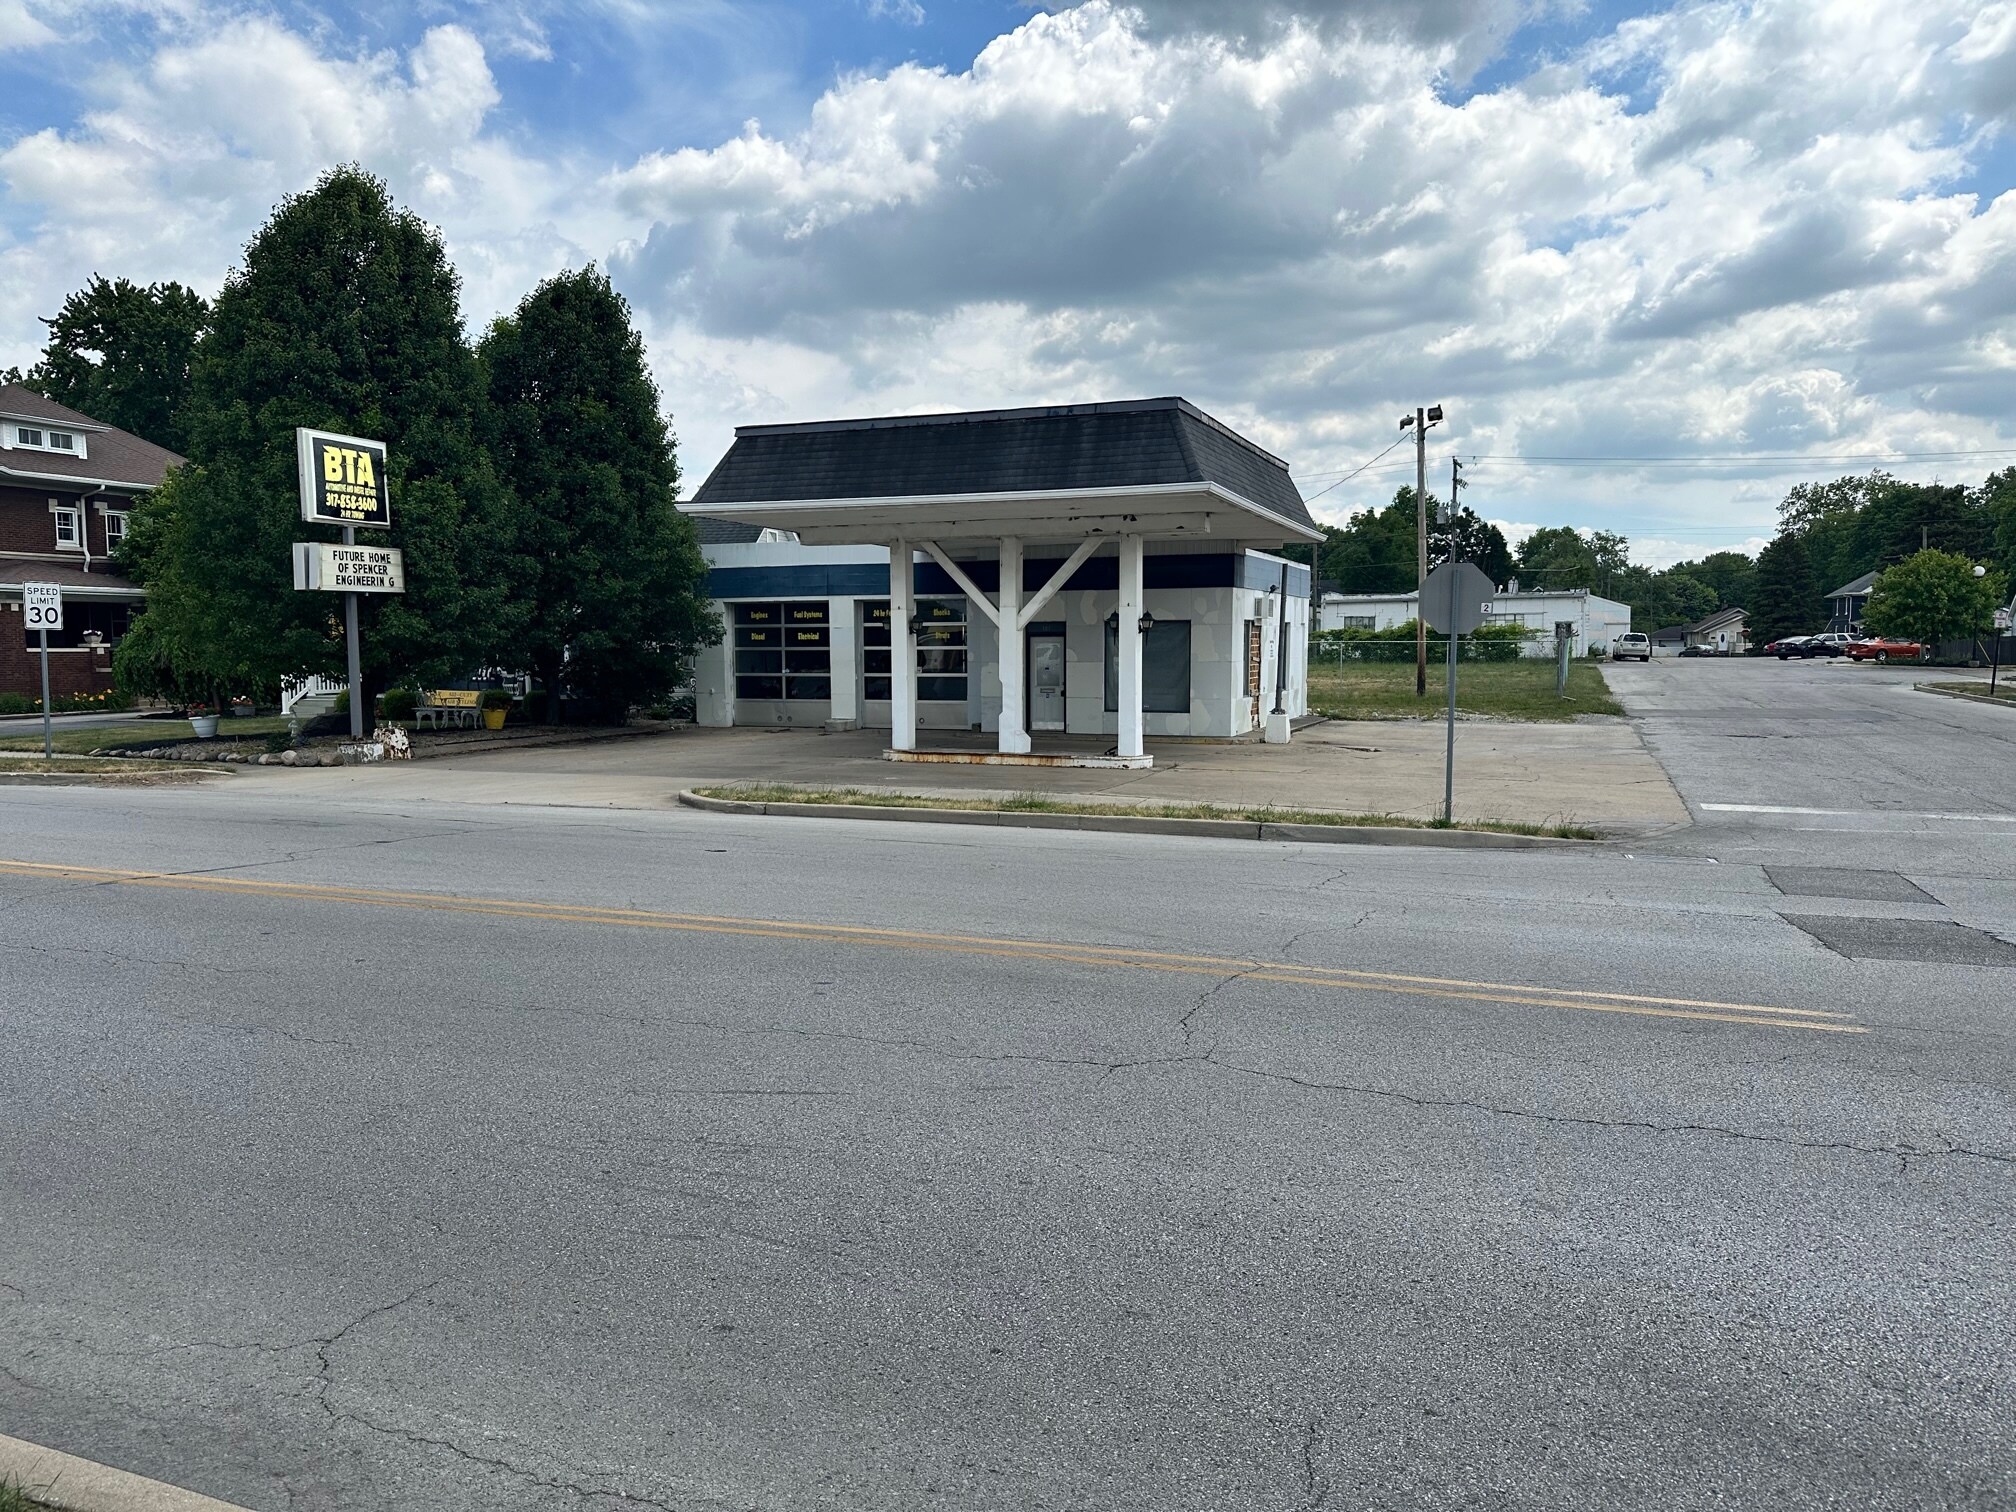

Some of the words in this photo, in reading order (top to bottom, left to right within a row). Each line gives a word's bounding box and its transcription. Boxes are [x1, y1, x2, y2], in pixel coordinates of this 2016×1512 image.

[323, 445, 375, 488] BTA
[325, 492, 377, 512] 317-858-3600
[332, 550, 365, 562] FUTURE
[368, 552, 391, 564] HOME
[338, 562, 349, 573] OF
[352, 563, 388, 575] SPENCER
[335, 574, 385, 587] ENGINEERIN
[388, 576, 395, 587] G
[27, 587, 58, 596] SPEED
[30, 597, 55, 605] LIMIT
[1483, 604, 1489, 612] 2
[29, 606, 59, 624] 30
